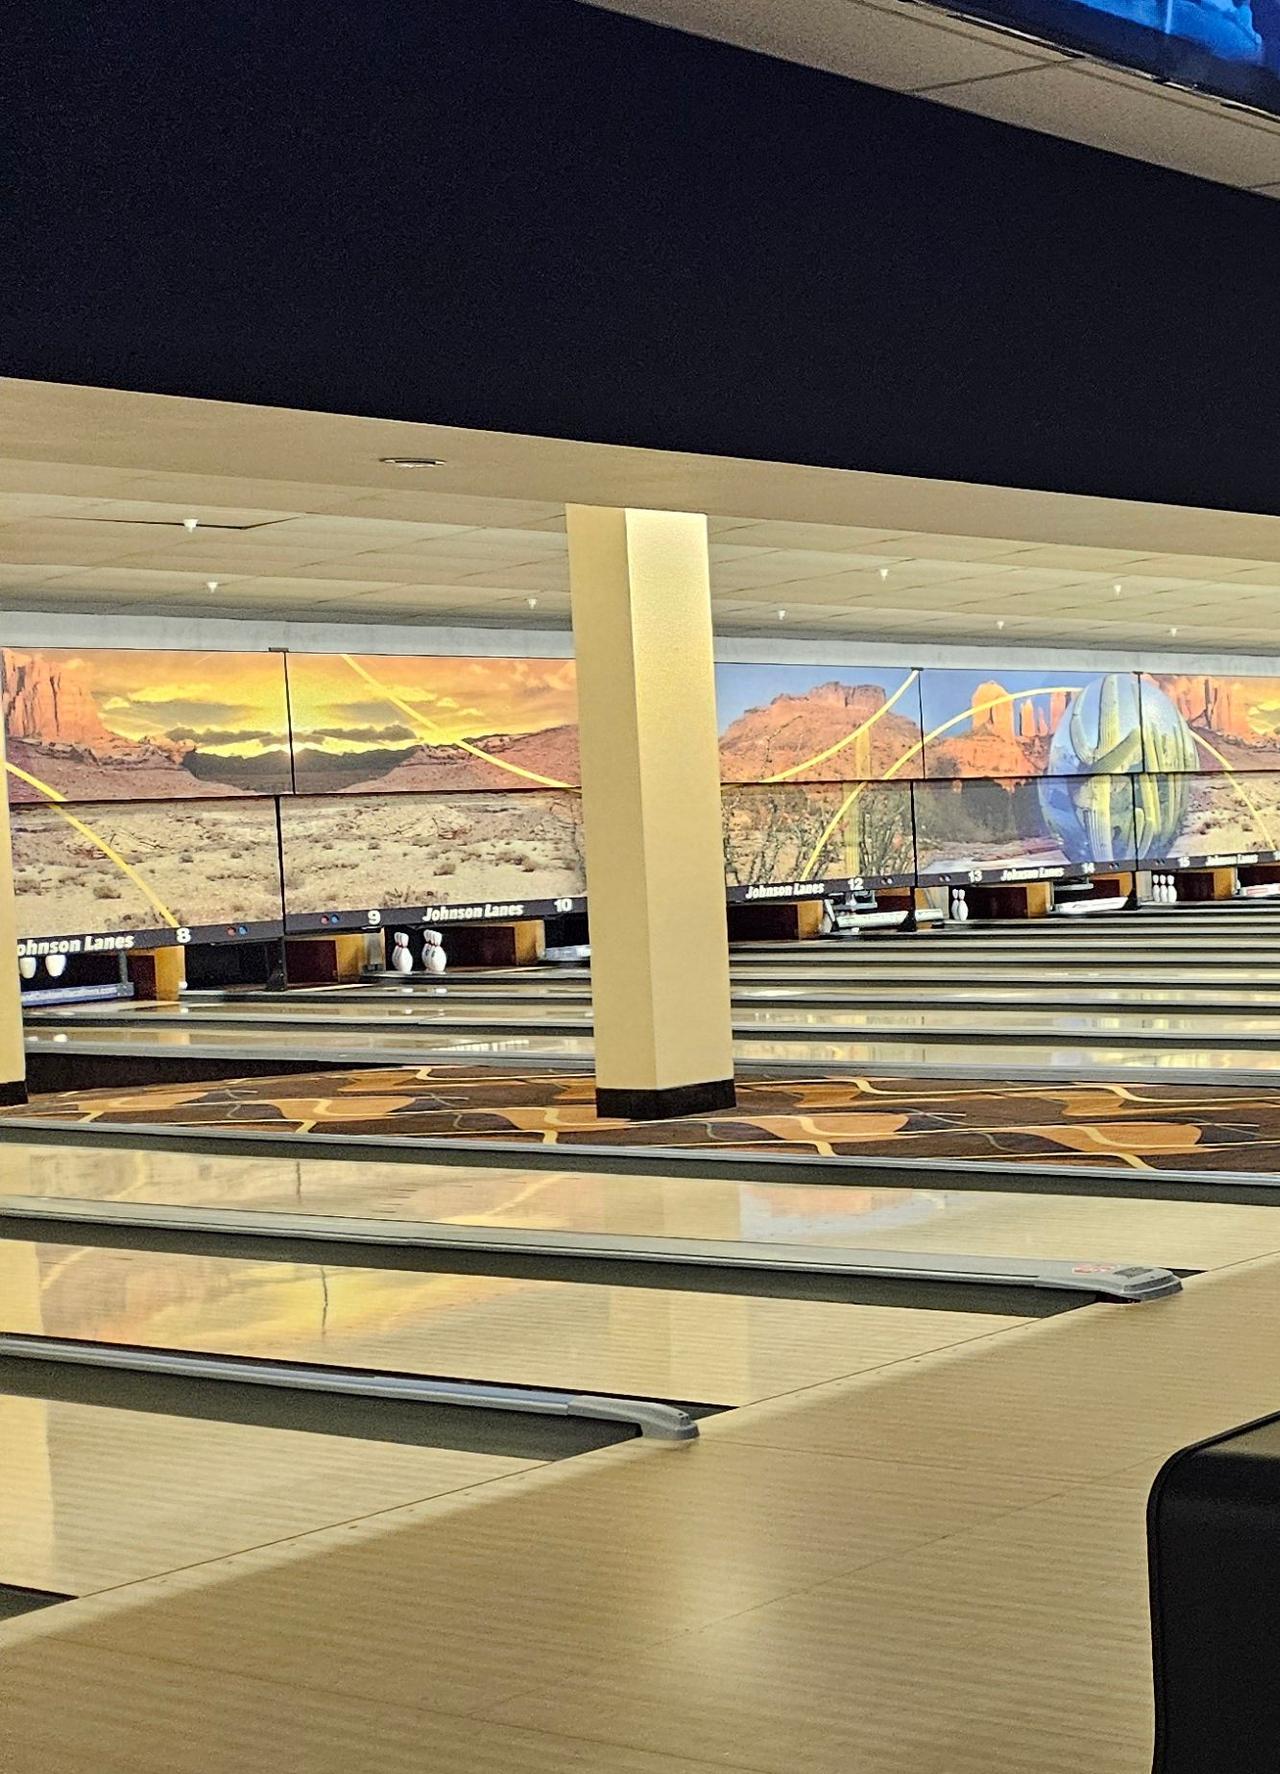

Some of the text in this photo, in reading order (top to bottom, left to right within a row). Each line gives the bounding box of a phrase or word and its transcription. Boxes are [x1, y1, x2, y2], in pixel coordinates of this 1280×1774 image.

[745, 877, 864, 899] Johnson Lanes 12
[967, 870, 983, 883] 13
[367, 898, 573, 925] 9 Johnson Lanes 10
[17, 927, 192, 956] ohnson Lanes 8
